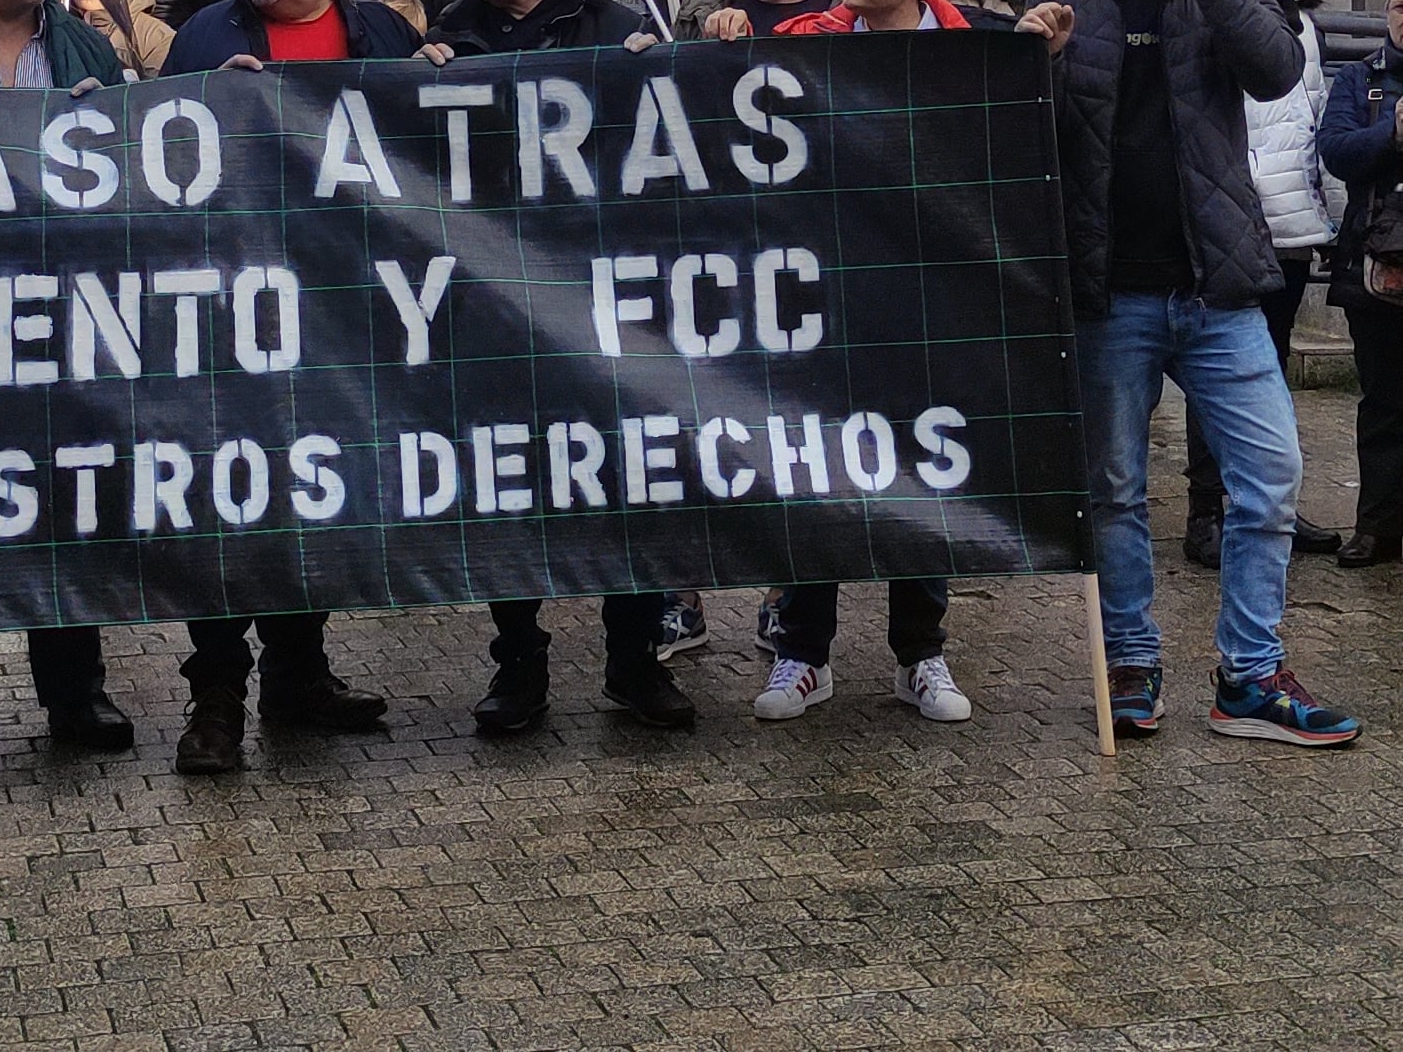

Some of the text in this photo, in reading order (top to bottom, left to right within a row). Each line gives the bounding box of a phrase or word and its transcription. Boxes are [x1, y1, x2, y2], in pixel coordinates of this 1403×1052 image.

[313, 64, 809, 203] ATRAS
[375, 255, 457, 366] Y
[590, 247, 825, 359] FCC
[399, 405, 972, 519] DERECHOS
